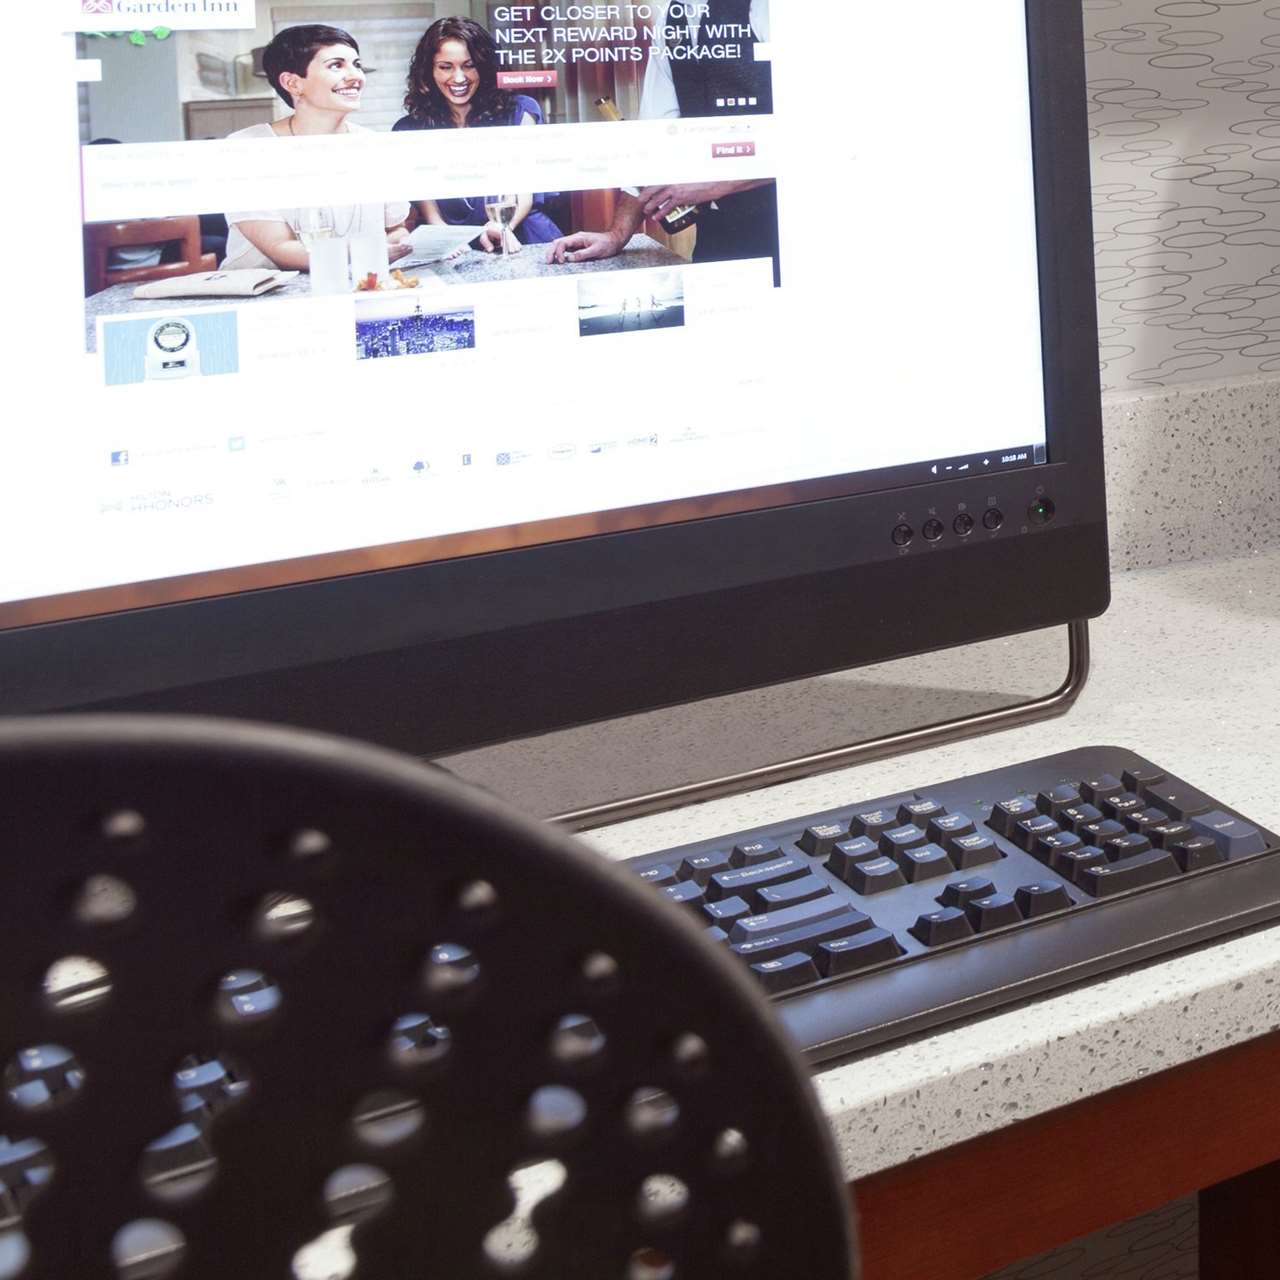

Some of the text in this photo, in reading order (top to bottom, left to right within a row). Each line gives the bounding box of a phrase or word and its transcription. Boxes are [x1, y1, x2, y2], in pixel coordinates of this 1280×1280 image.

[117, 0, 239, 14] Garden Inn
[494, 3, 710, 22] GET CLOSER TO YOUR
[495, 23, 752, 44] NEXT REWARD NIGHT WITH
[495, 45, 742, 66] THE 2X POINTS PACKAGE!
